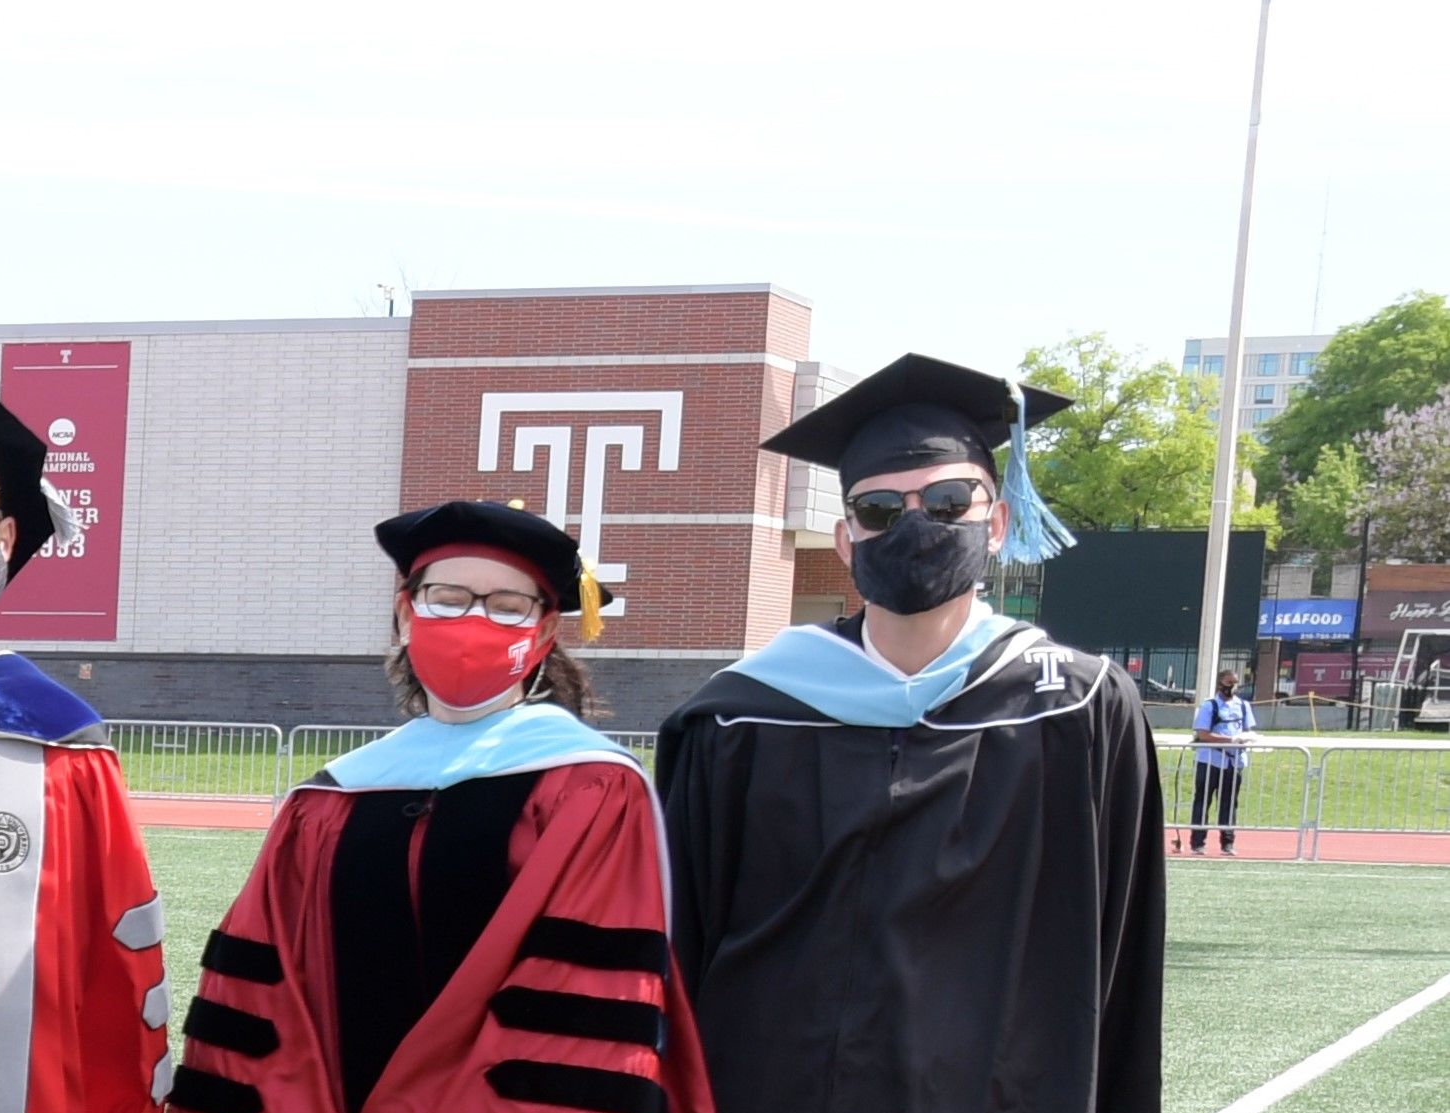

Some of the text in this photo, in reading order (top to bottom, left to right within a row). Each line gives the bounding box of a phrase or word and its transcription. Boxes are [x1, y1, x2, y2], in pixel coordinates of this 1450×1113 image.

[42, 462, 95, 472] AMPIONS
[478, 391, 683, 616] T
[1274, 612, 1342, 625] SEAFOOD
[1024, 646, 1074, 693] T
